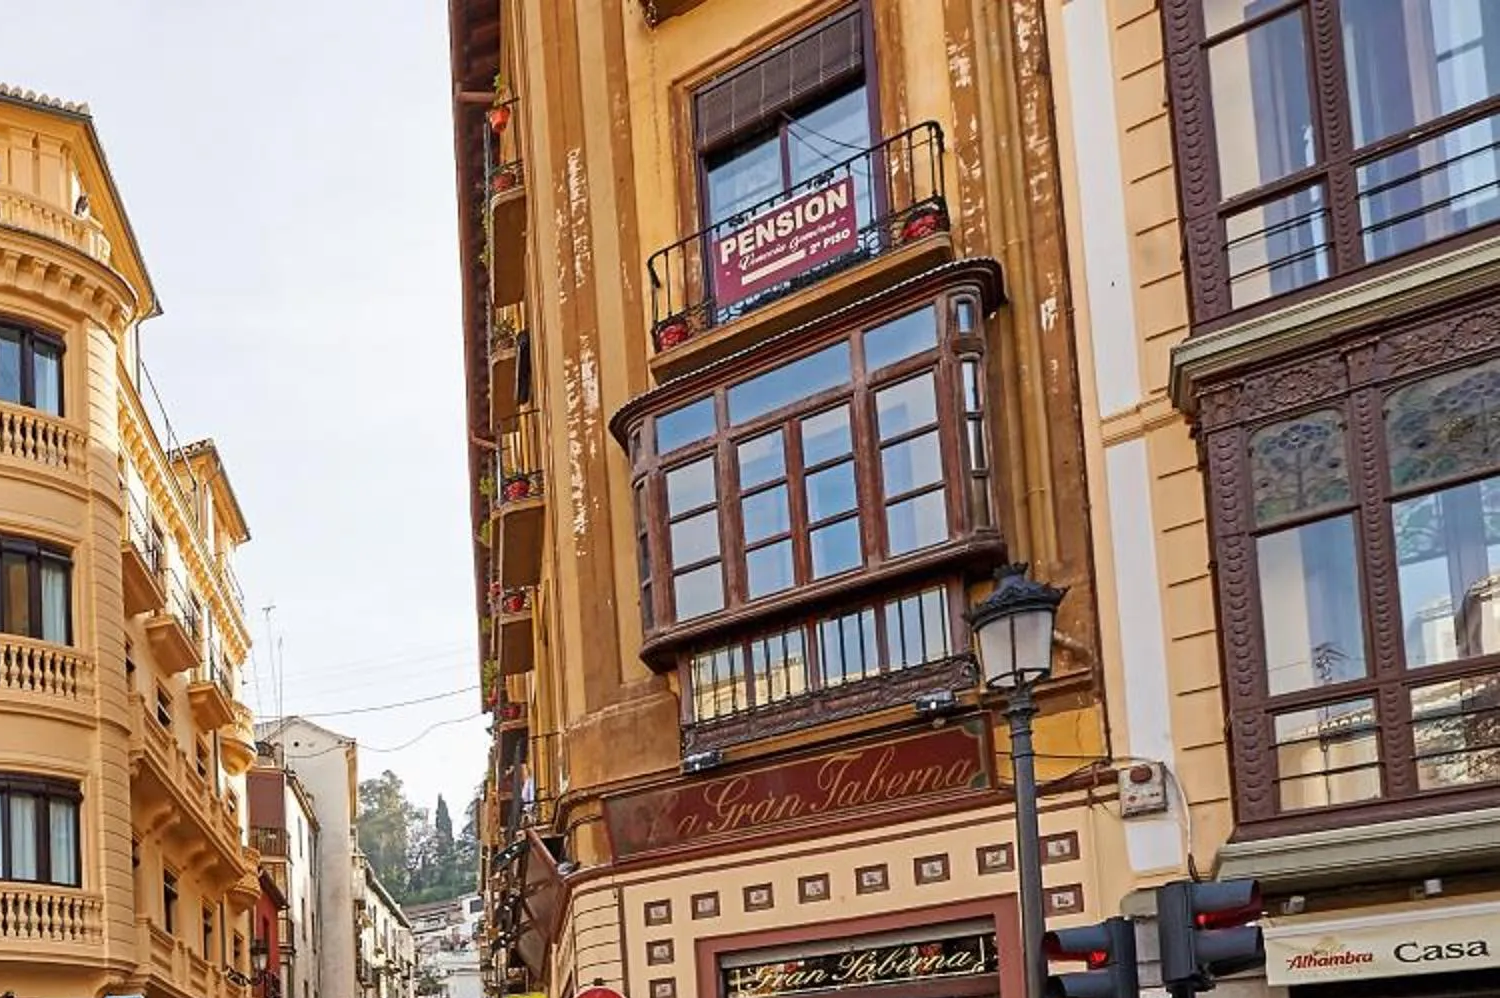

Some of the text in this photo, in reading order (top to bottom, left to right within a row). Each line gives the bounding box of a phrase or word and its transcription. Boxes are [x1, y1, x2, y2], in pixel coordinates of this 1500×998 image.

[720, 183, 848, 265] PENSION
[823, 228, 851, 249] PISO
[810, 745, 978, 811] Taberna
[747, 948, 974, 992] Gran Taberna
[1286, 939, 1491, 970] Alhambra Casa
